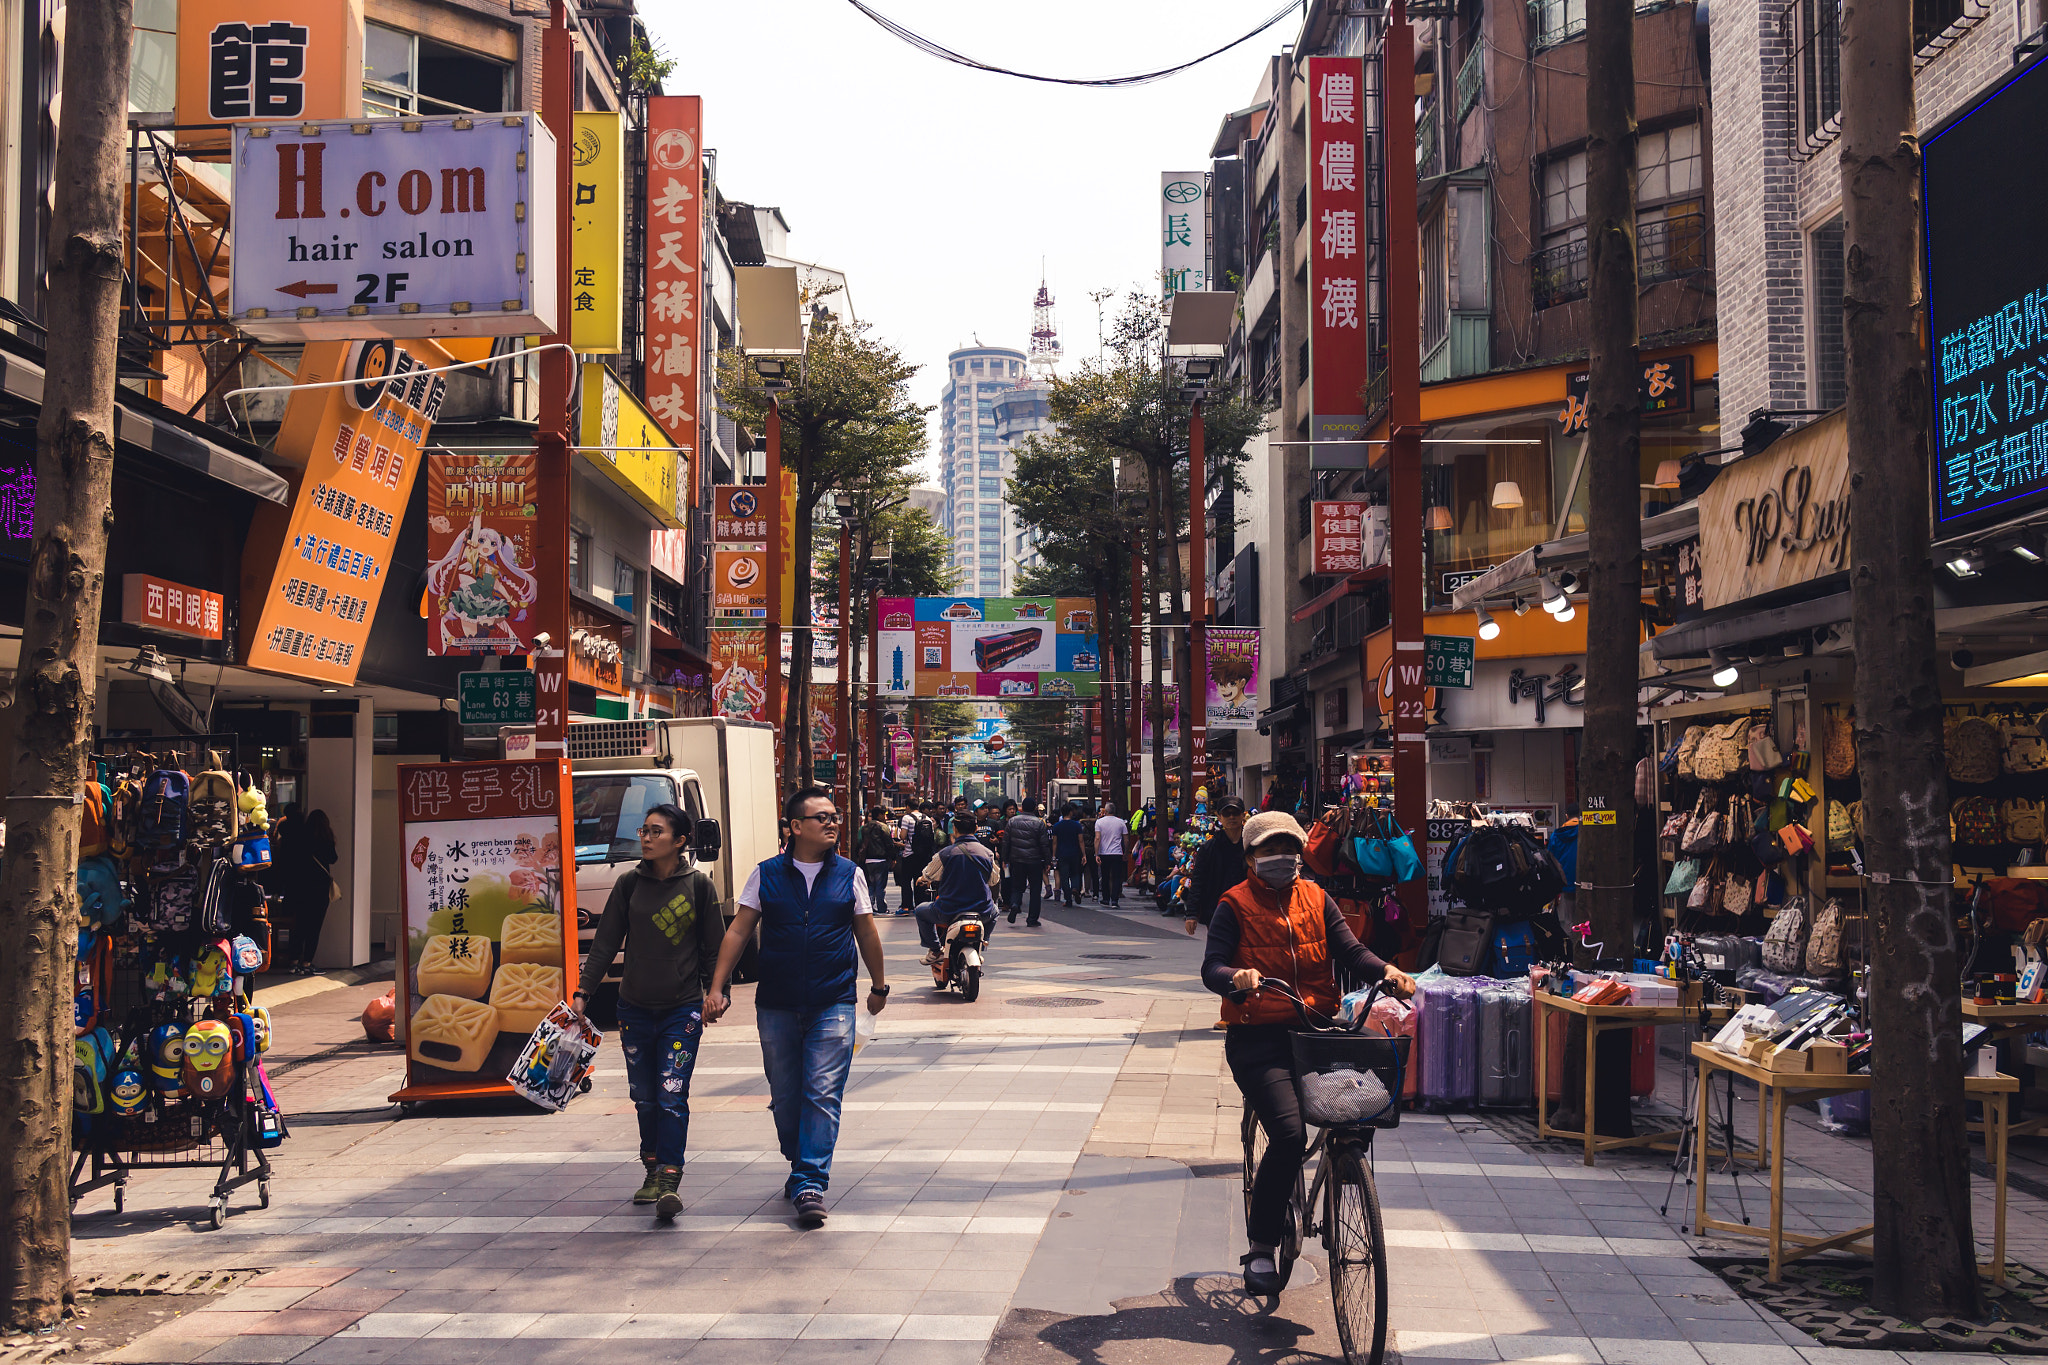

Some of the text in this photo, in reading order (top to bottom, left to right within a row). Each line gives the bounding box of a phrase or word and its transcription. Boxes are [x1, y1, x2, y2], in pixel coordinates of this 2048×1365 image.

[209, 21, 309, 119] 館
[275, 142, 487, 219] H.com
[1318, 72, 1358, 329] 儂儂褲襪
[288, 232, 474, 262] hair salon
[354, 272, 409, 304] 2F
[574, 266, 596, 312] 定食
[649, 177, 696, 429] 老天祿滷味
[1943, 381, 1998, 448] 防水
[332, 424, 404, 492] 專營項目
[444, 481, 526, 508] 西門町
[1321, 504, 1361, 517] 專賣
[1321, 519, 1361, 570] 健康襪
[301, 533, 374, 581] 流行禮品百貨
[146, 582, 219, 633] 西門眼鏡
[1209, 641, 1256, 657] 西門町
[1426, 654, 1466, 673] 50 巷
[464, 676, 534, 689] 武昌街二段
[538, 672, 562, 693] W
[1400, 665, 1422, 685] W
[493, 691, 532, 708] 63 巷
[1509, 663, 1585, 724] 阿毛
[466, 701, 486, 709] Lane
[1398, 701, 1424, 718] 22
[465, 711, 497, 720] WuChang
[536, 708, 560, 726] 21
[1193, 737, 1205, 748] W
[837, 761, 846, 769] W
[1132, 760, 1140, 768] W
[1192, 755, 1206, 764] 20
[407, 765, 554, 816] 伴手礼
[1588, 797, 1606, 808] 24K
[471, 840, 493, 849] green
[494, 838, 513, 846] bean
[427, 851, 440, 912] 台灣伴手禮
[166, 1025, 180, 1036] A
[123, 1074, 133, 1084] A
